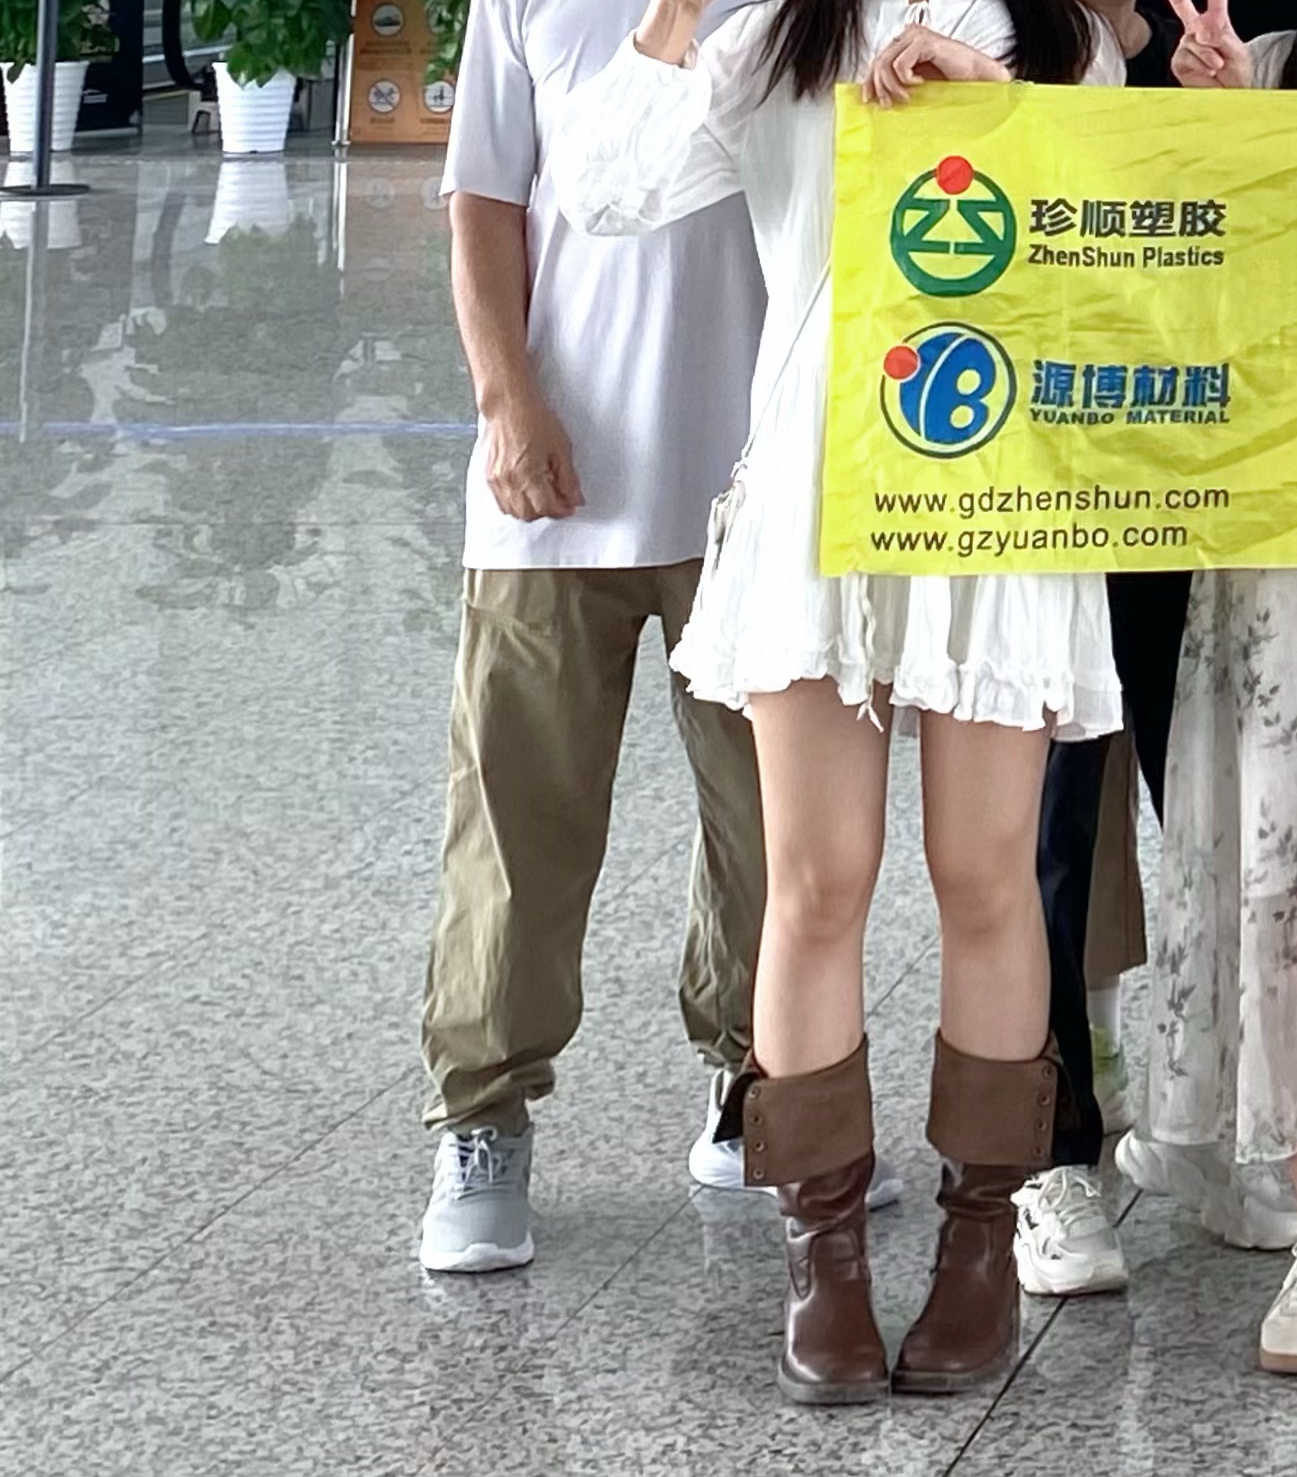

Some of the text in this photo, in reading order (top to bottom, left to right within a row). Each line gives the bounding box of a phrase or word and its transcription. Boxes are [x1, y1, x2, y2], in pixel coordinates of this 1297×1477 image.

[1029, 198, 1227, 238] 珍顺塑胶
[1028, 244, 1225, 267] ZhenShun Plastics
[1031, 360, 1231, 409] 源博材料
[1030, 409, 1230, 425] YUANBO MATERIAL
[874, 484, 1230, 519] www.gdzhenshun.com
[870, 523, 1188, 557] www.gzyuanbo.com
